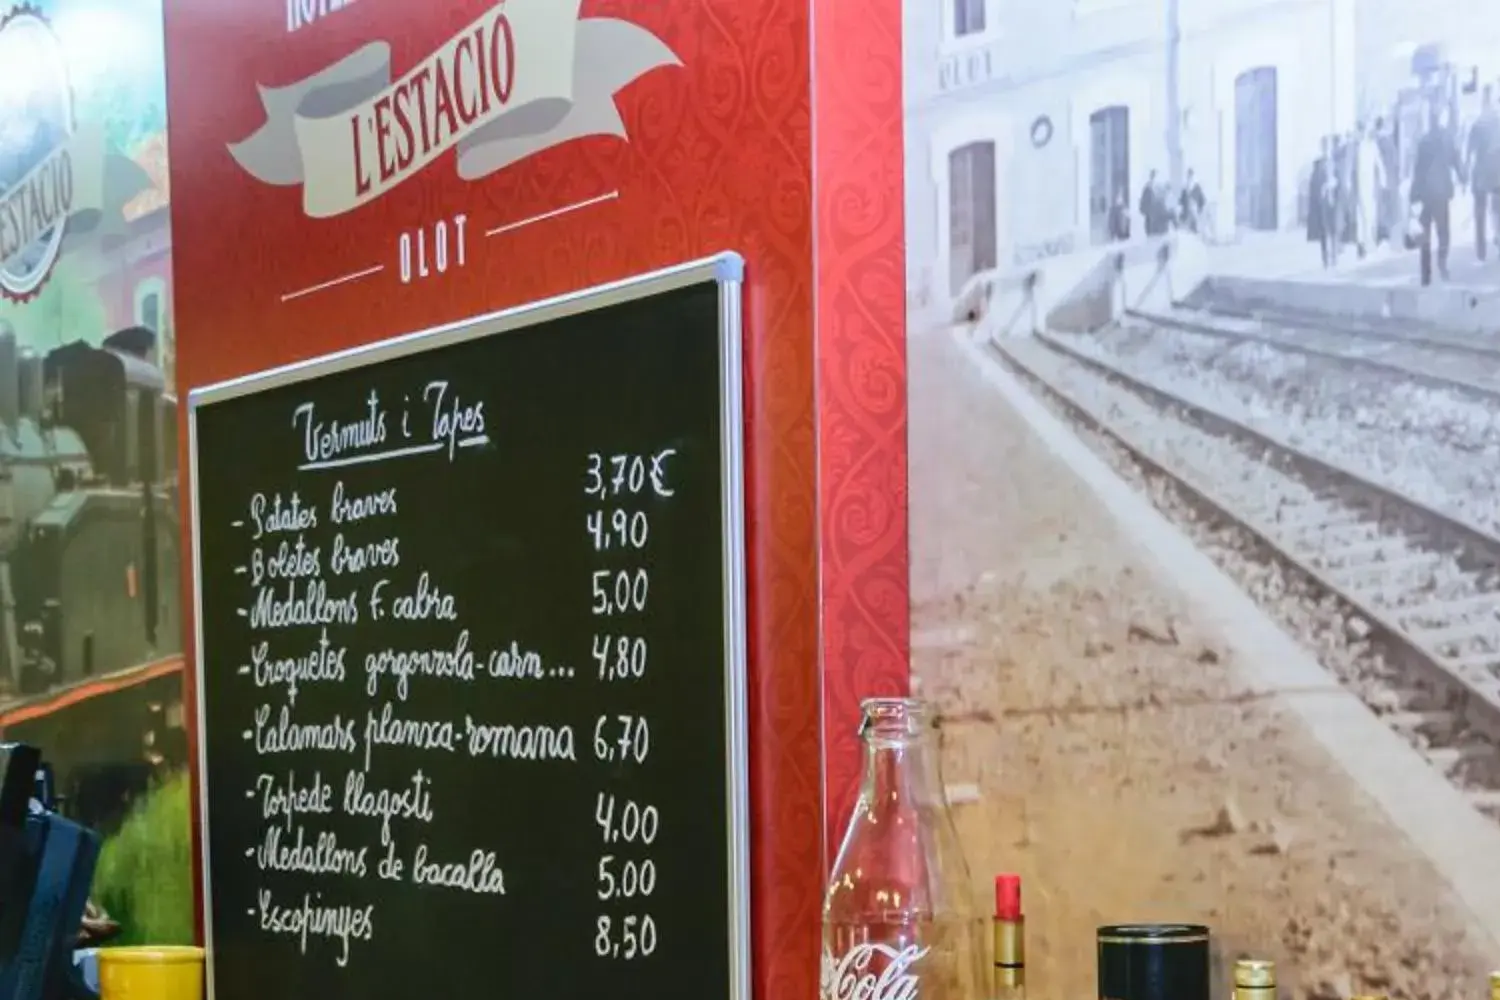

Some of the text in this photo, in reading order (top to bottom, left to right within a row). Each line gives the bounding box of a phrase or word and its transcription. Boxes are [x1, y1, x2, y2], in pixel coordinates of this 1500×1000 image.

[400, 213, 467, 283] OLOT
[293, 380, 485, 463] Vermuts i Tapes
[330, 480, 397, 525] braves
[330, 532, 400, 576] braves
[391, 571, 458, 621] cabra
[591, 634, 647, 681] 4,80
[593, 714, 649, 764] 6,70
[377, 841, 404, 881] de
[595, 914, 657, 960] 8,50
